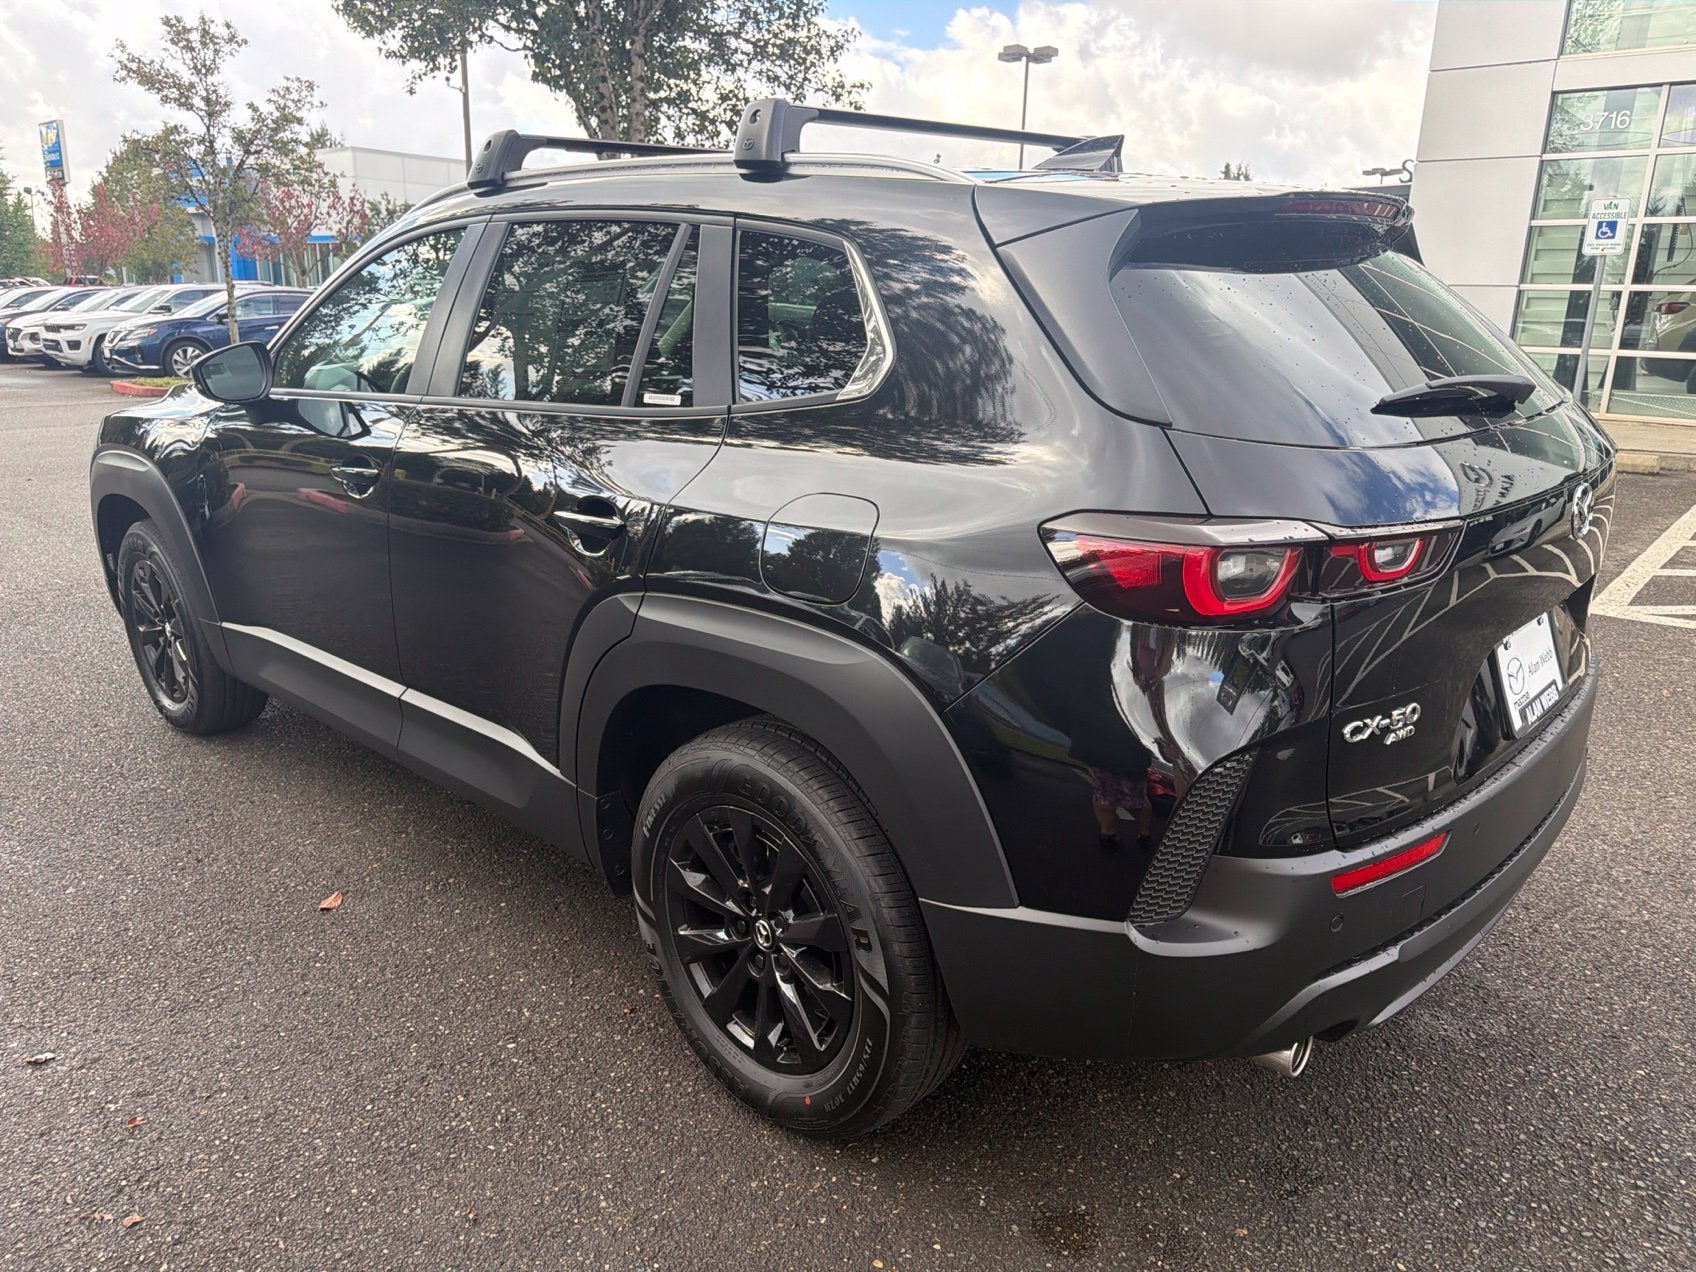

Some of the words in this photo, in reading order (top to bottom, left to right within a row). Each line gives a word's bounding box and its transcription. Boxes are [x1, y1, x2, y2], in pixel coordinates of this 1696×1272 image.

[1580, 110, 1631, 131] 3716
[1591, 211, 1628, 220] ACCESSIBLE
[1603, 202, 1619, 210] VAN
[1528, 660, 1540, 678] Alan
[1526, 697, 1543, 725] ALAN
[1342, 702, 1421, 743] CX-50
[1384, 725, 1415, 745] AWD
[736, 776, 873, 953] GOODYEAR
